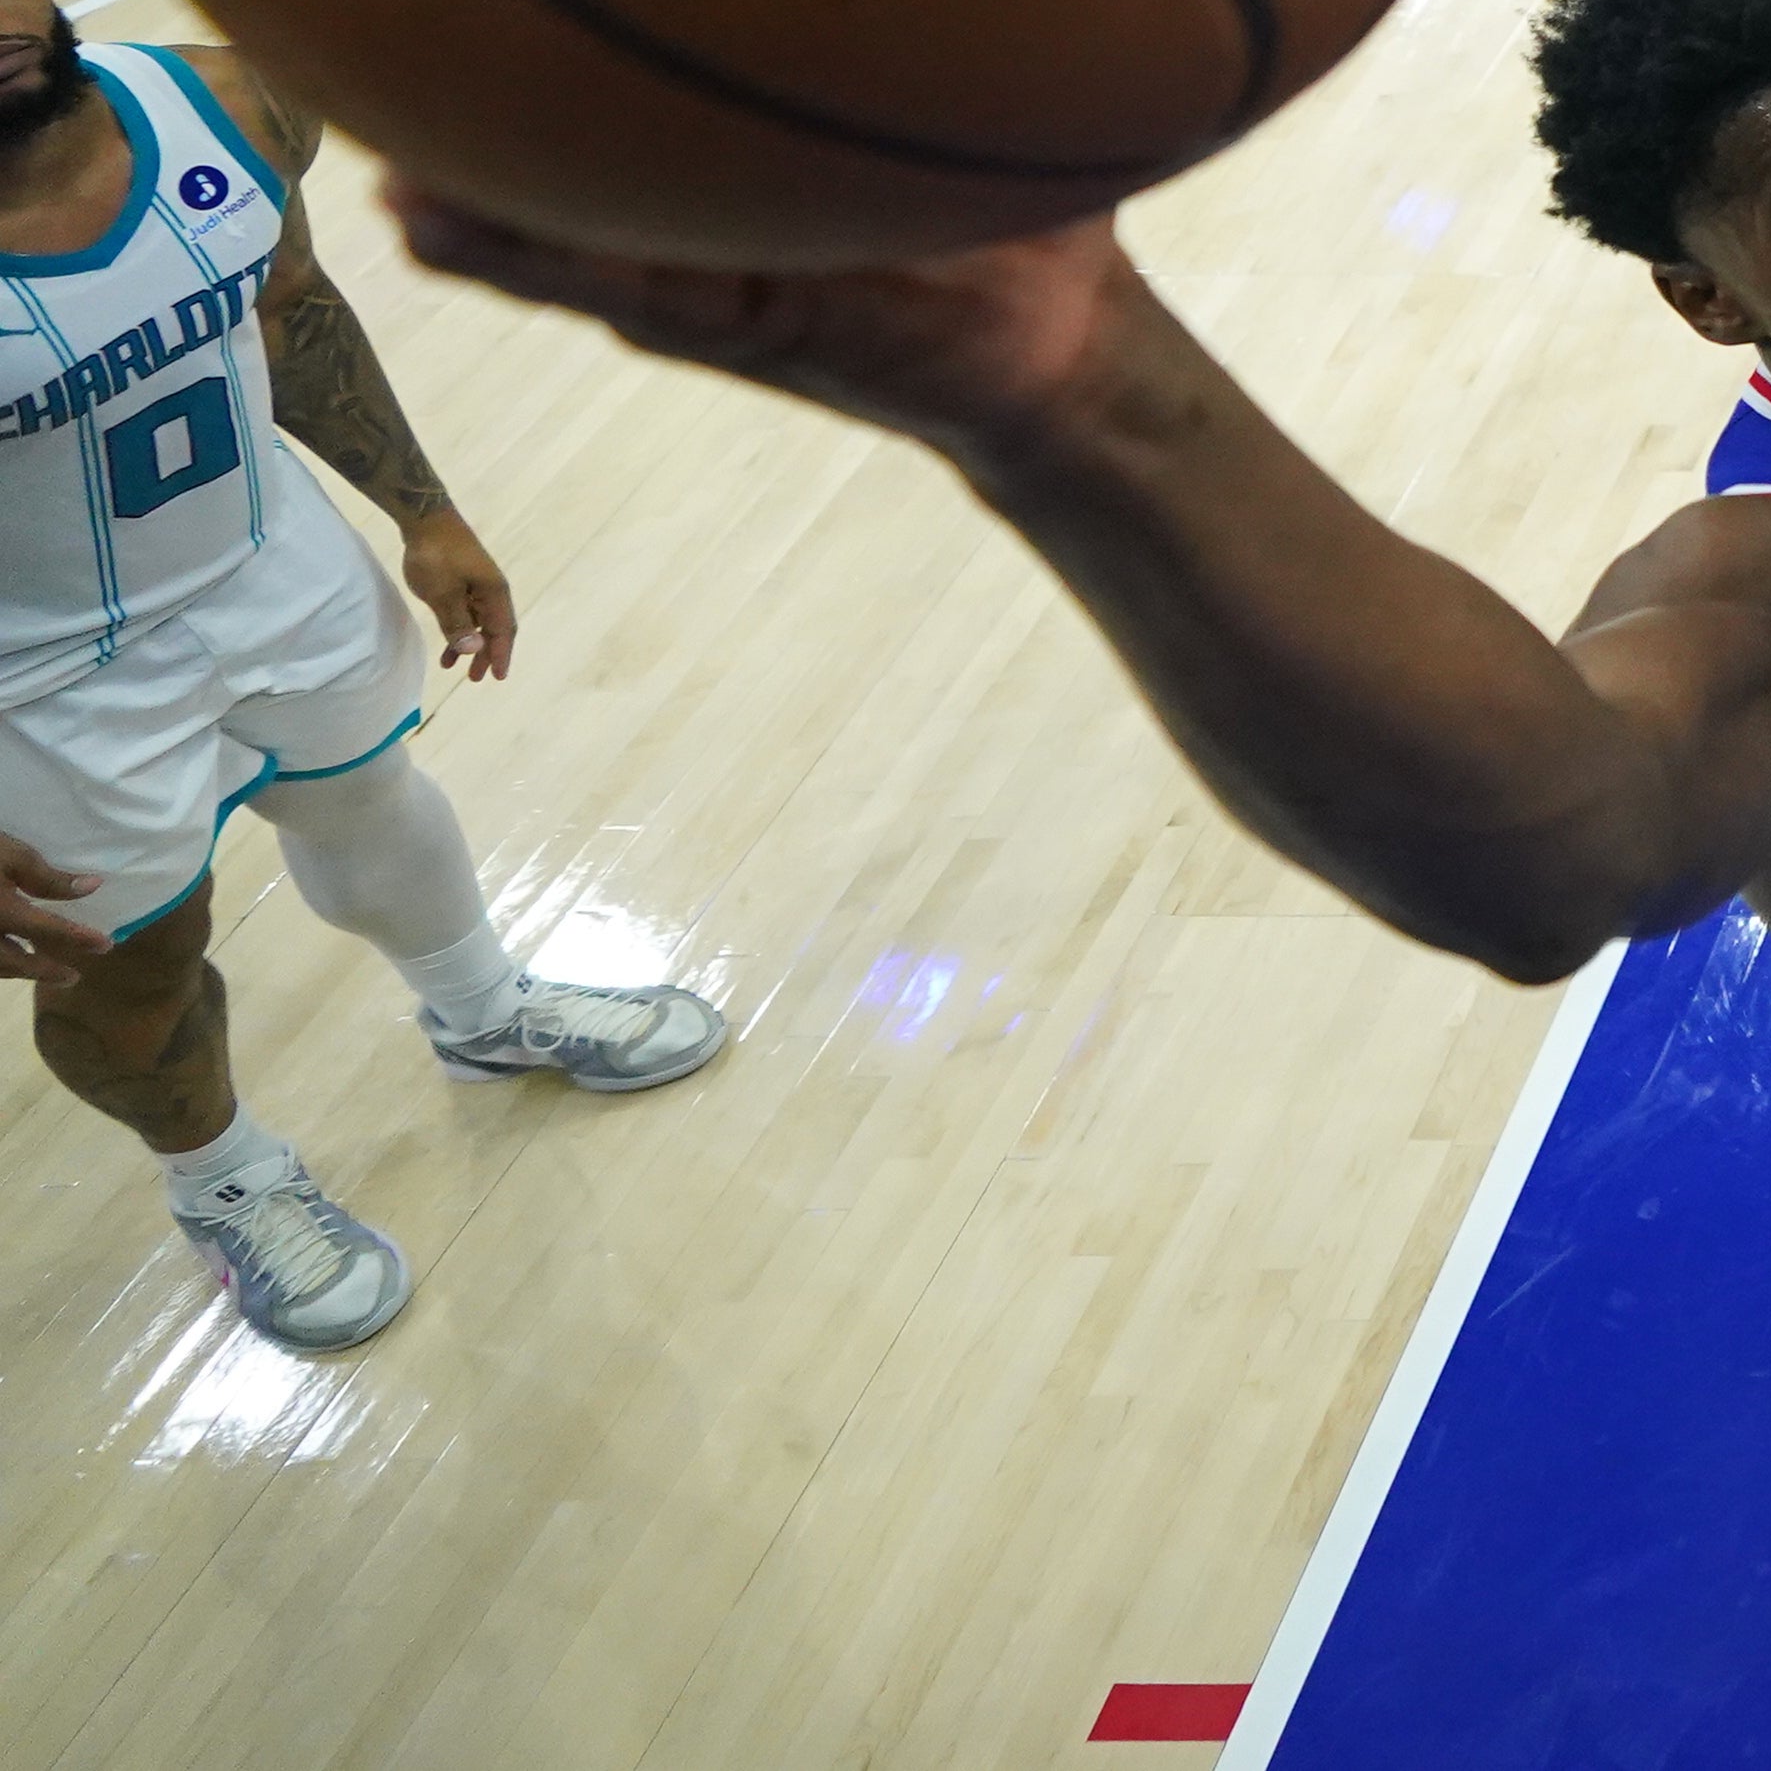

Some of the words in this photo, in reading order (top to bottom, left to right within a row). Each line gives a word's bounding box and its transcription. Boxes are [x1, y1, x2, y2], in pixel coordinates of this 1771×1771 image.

[189, 214, 223, 241] Judi
[218, 187, 261, 220] Health
[103, 375, 241, 520] 0
